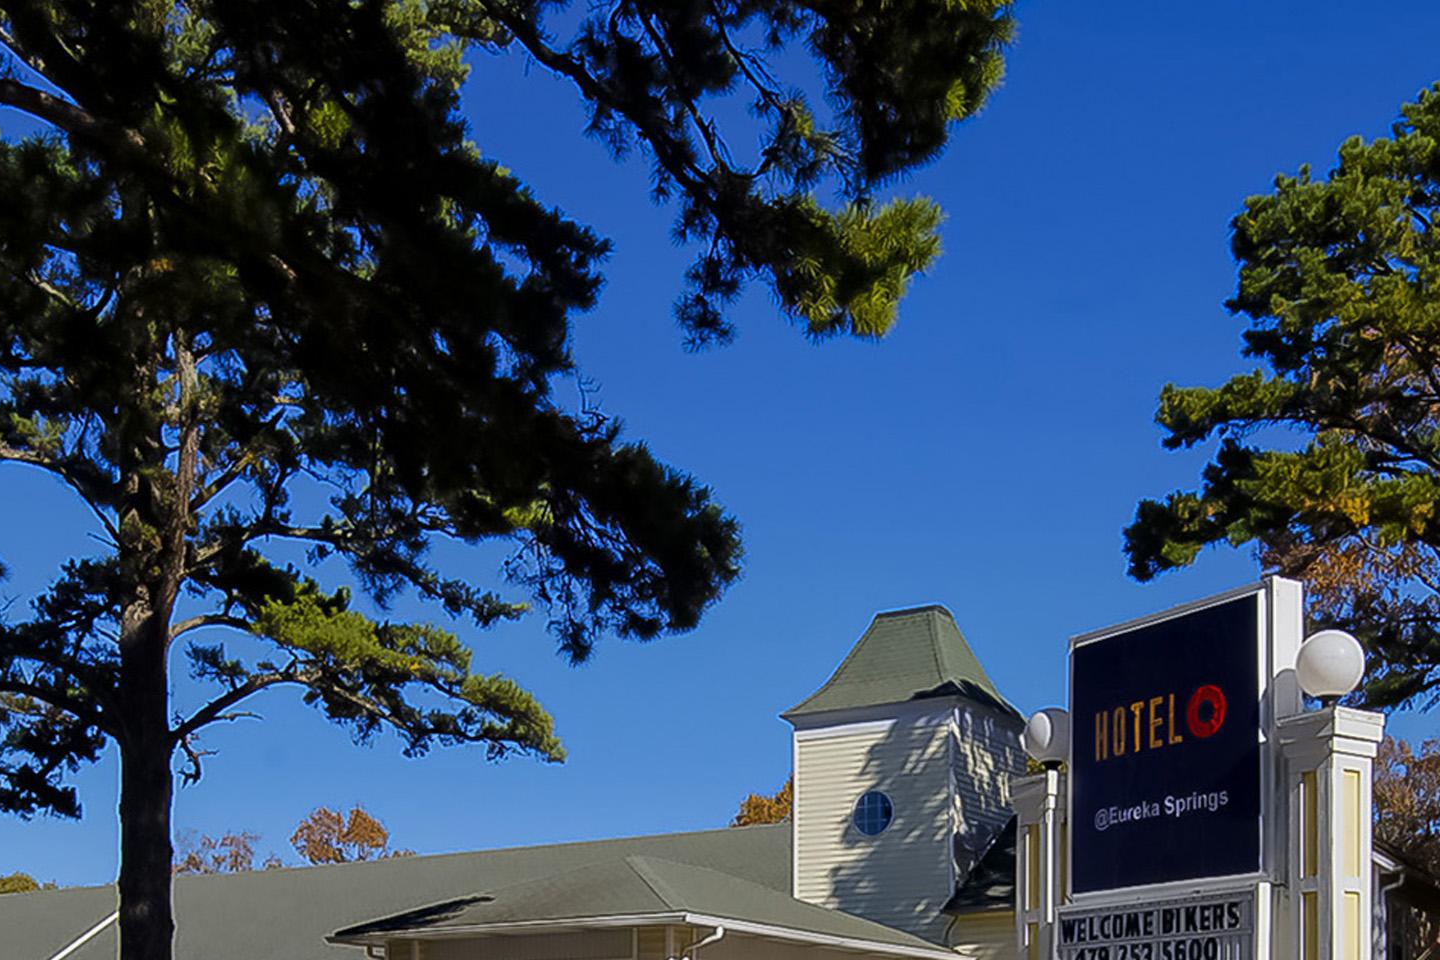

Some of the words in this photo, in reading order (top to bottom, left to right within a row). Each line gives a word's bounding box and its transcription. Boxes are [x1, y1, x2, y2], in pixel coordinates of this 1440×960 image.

[1095, 694, 1183, 762] HOTEL
[1094, 801, 1160, 831] @Eureka
[1164, 790, 1229, 817] Springs
[1062, 911, 1153, 943] WELCOME
[1162, 902, 1240, 934] BIKERS
